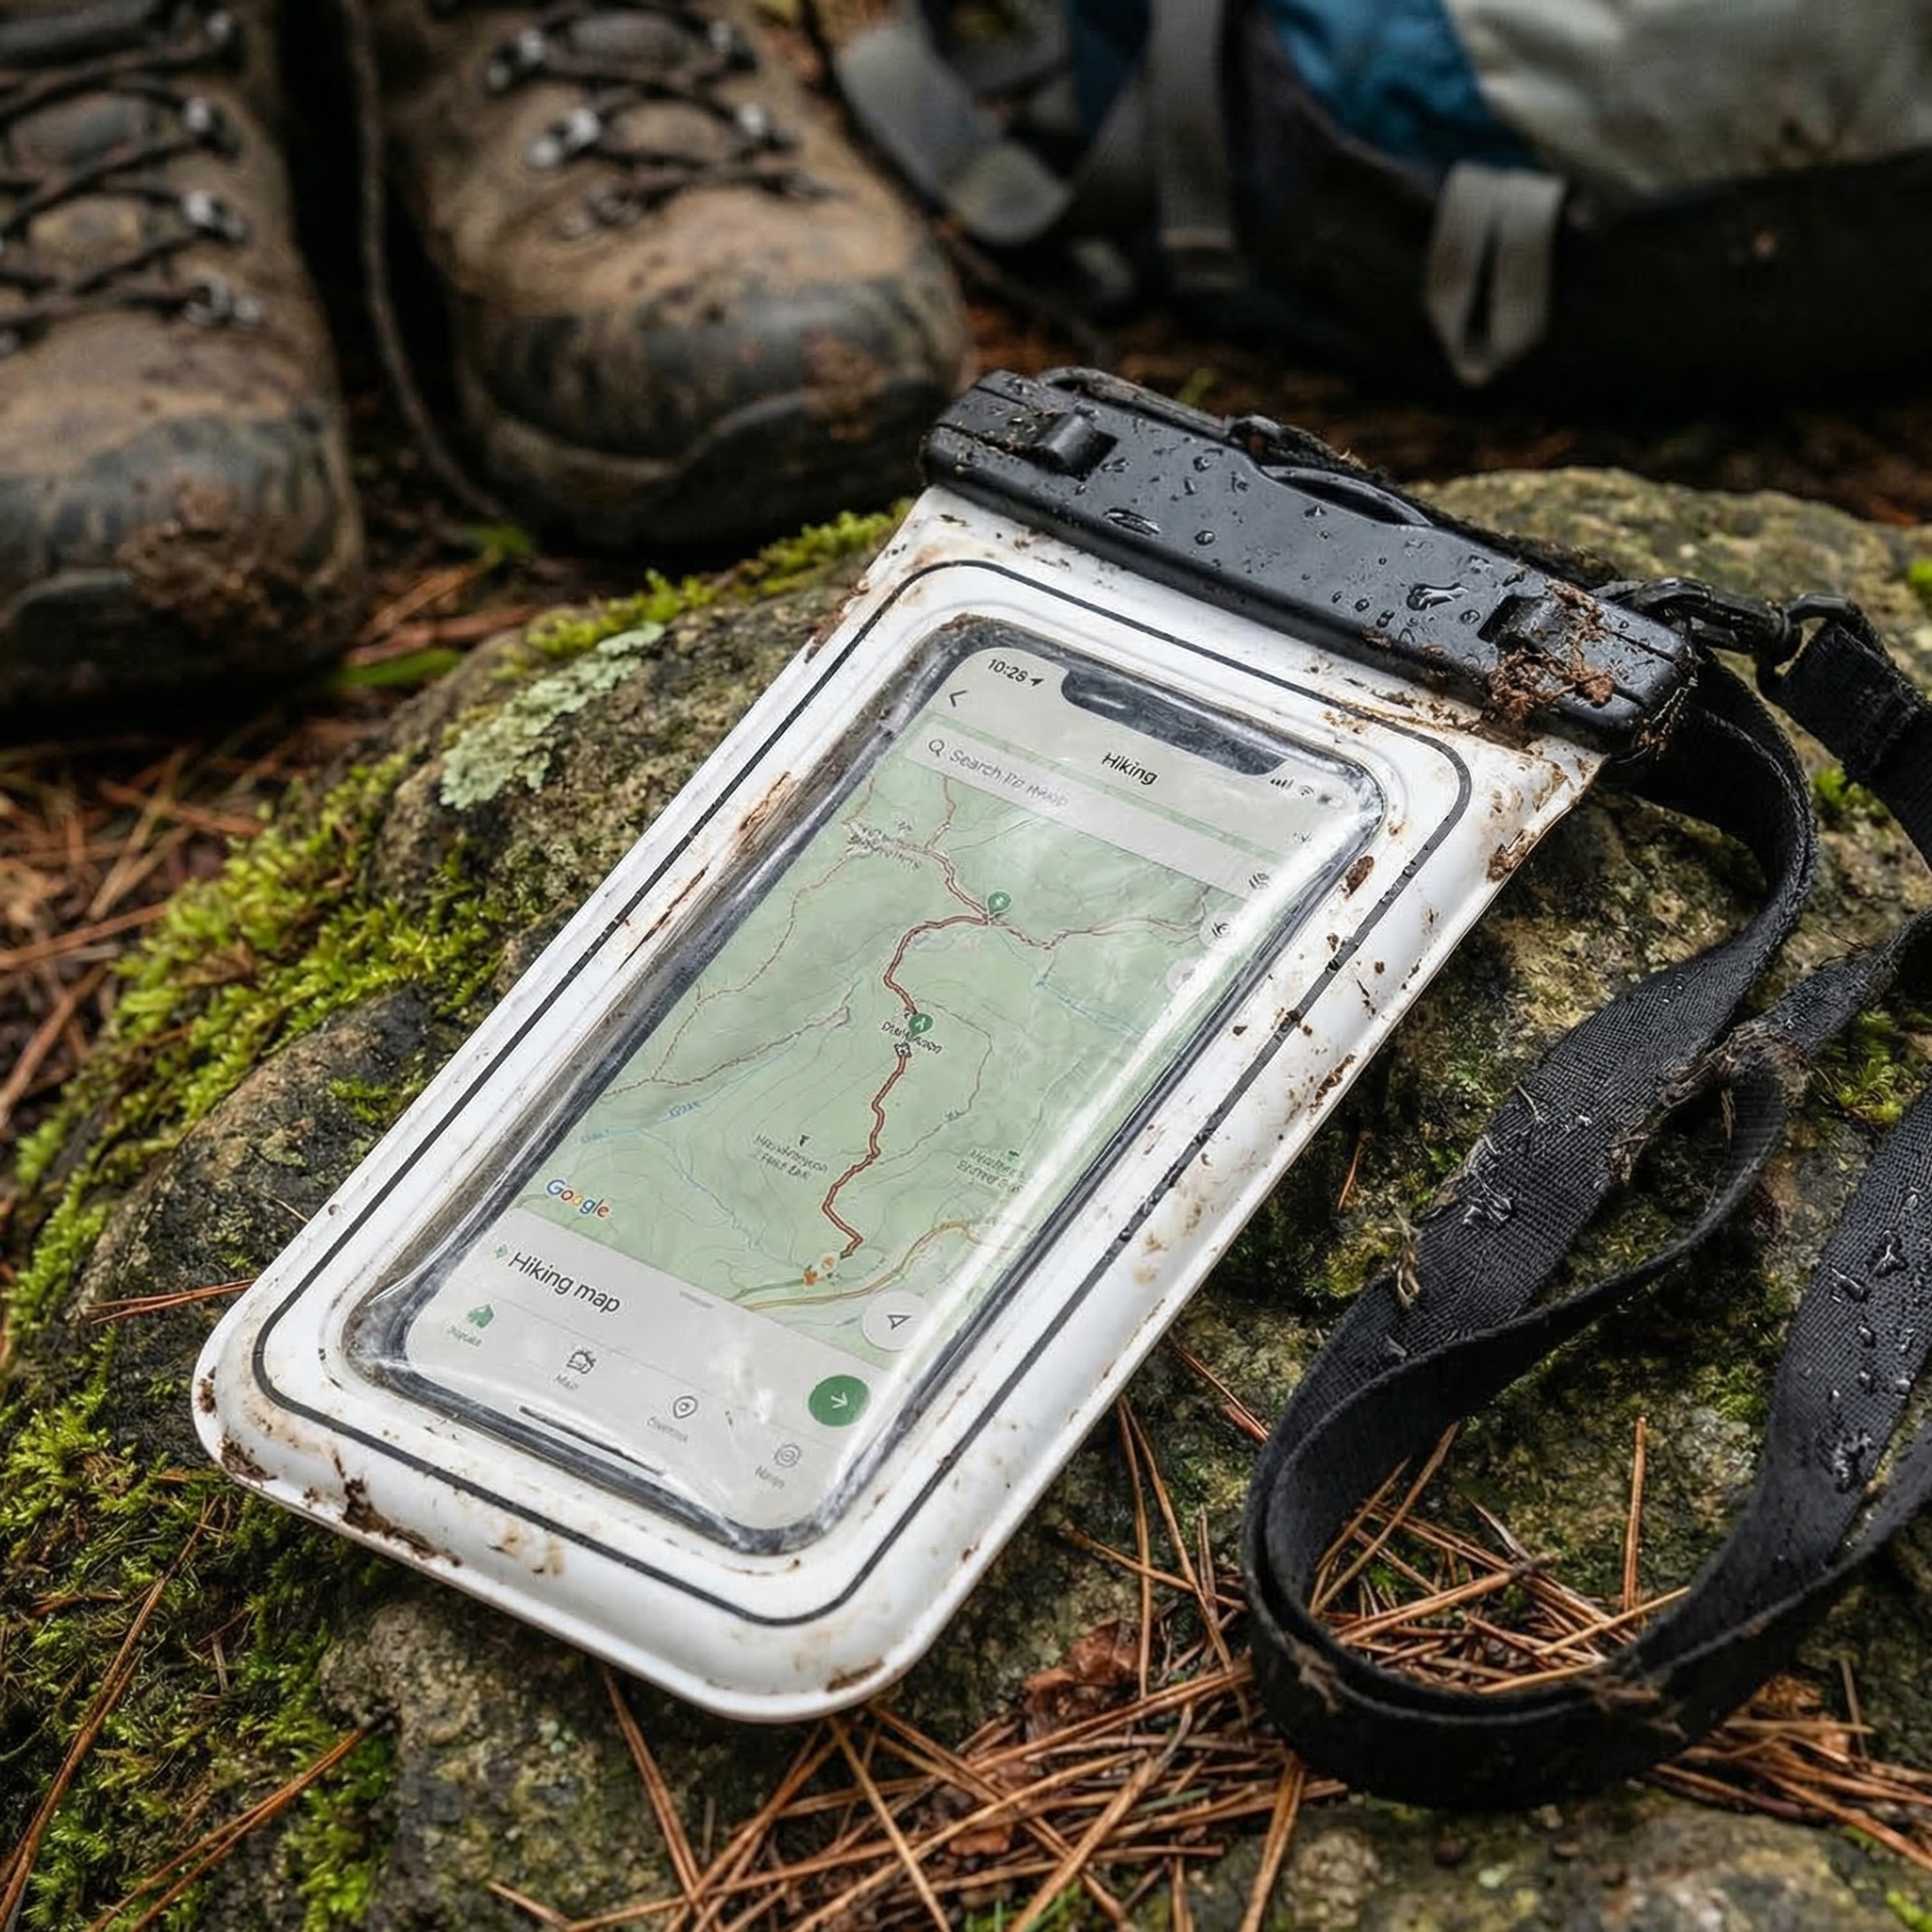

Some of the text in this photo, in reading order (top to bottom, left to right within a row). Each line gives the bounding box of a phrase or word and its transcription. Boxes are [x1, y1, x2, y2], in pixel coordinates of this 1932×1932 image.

[949, 749, 1002, 781] Search
[1101, 752, 1158, 786] Hiking
[546, 1179, 609, 1218] Google
[508, 1252, 621, 1313] Hiking map
